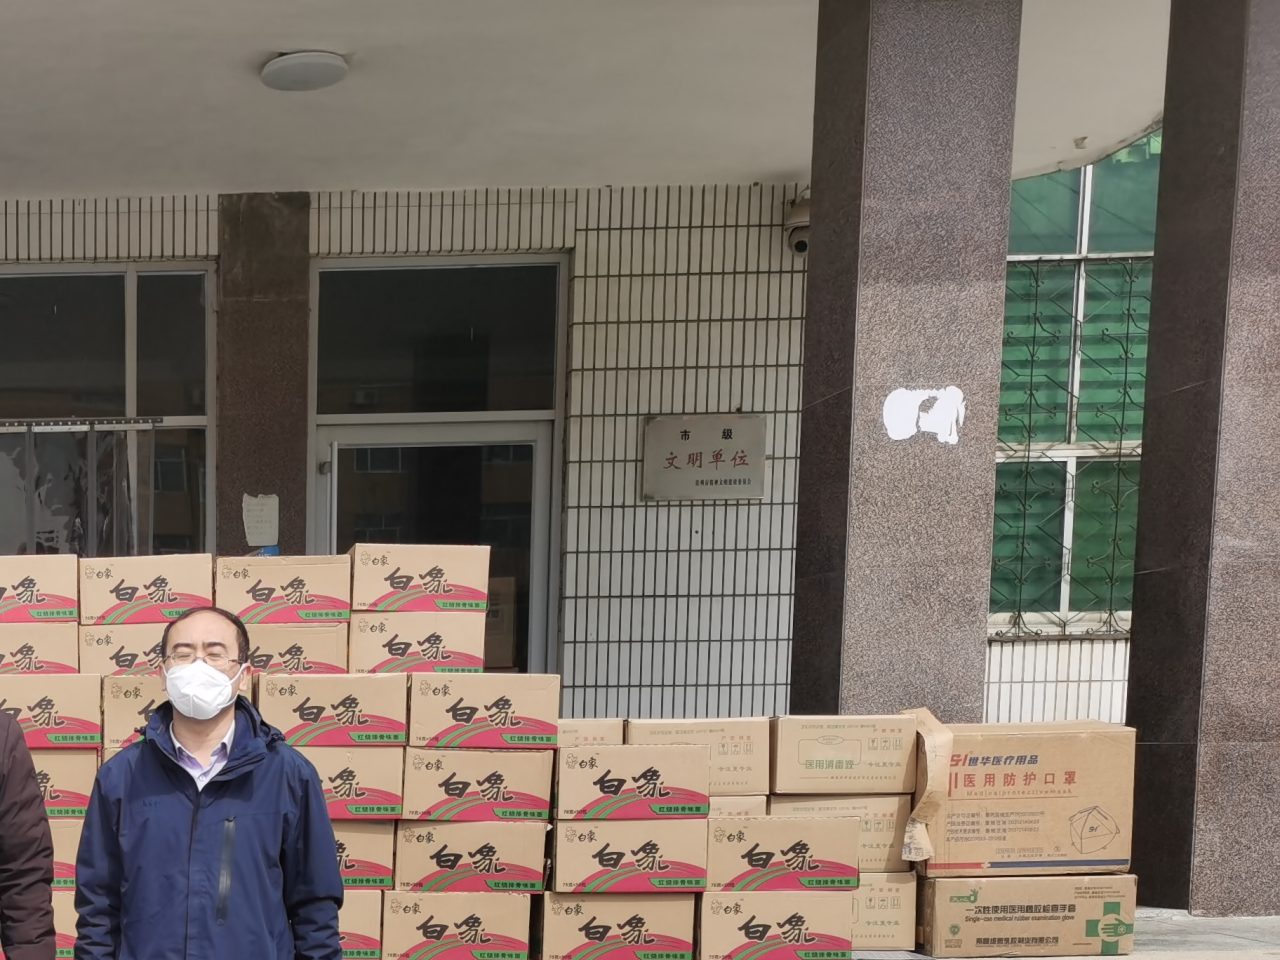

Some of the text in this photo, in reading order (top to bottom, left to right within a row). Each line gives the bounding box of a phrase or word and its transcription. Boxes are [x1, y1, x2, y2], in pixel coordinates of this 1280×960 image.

[680, 429, 733, 441] 市级
[663, 449, 749, 470] 文明单位
[110, 575, 178, 603] 白象
[246, 576, 317, 605] 白象
[384, 565, 454, 594] 白象
[248, 643, 315, 672] 白象
[382, 632, 453, 661] 白象
[292, 694, 369, 726] 白象
[446, 696, 522, 728] 白象
[968, 755, 1039, 766] 世华医疗用品
[438, 771, 514, 802] 白象
[593, 766, 671, 797] 白象
[964, 771, 1077, 788] 医用防护口罩
[430, 843, 506, 874] 白象
[592, 840, 670, 871] 白象
[741, 840, 820, 871] 白象
[416, 914, 491, 944] 白象
[578, 914, 656, 944] 白象
[738, 912, 817, 944] 白象
